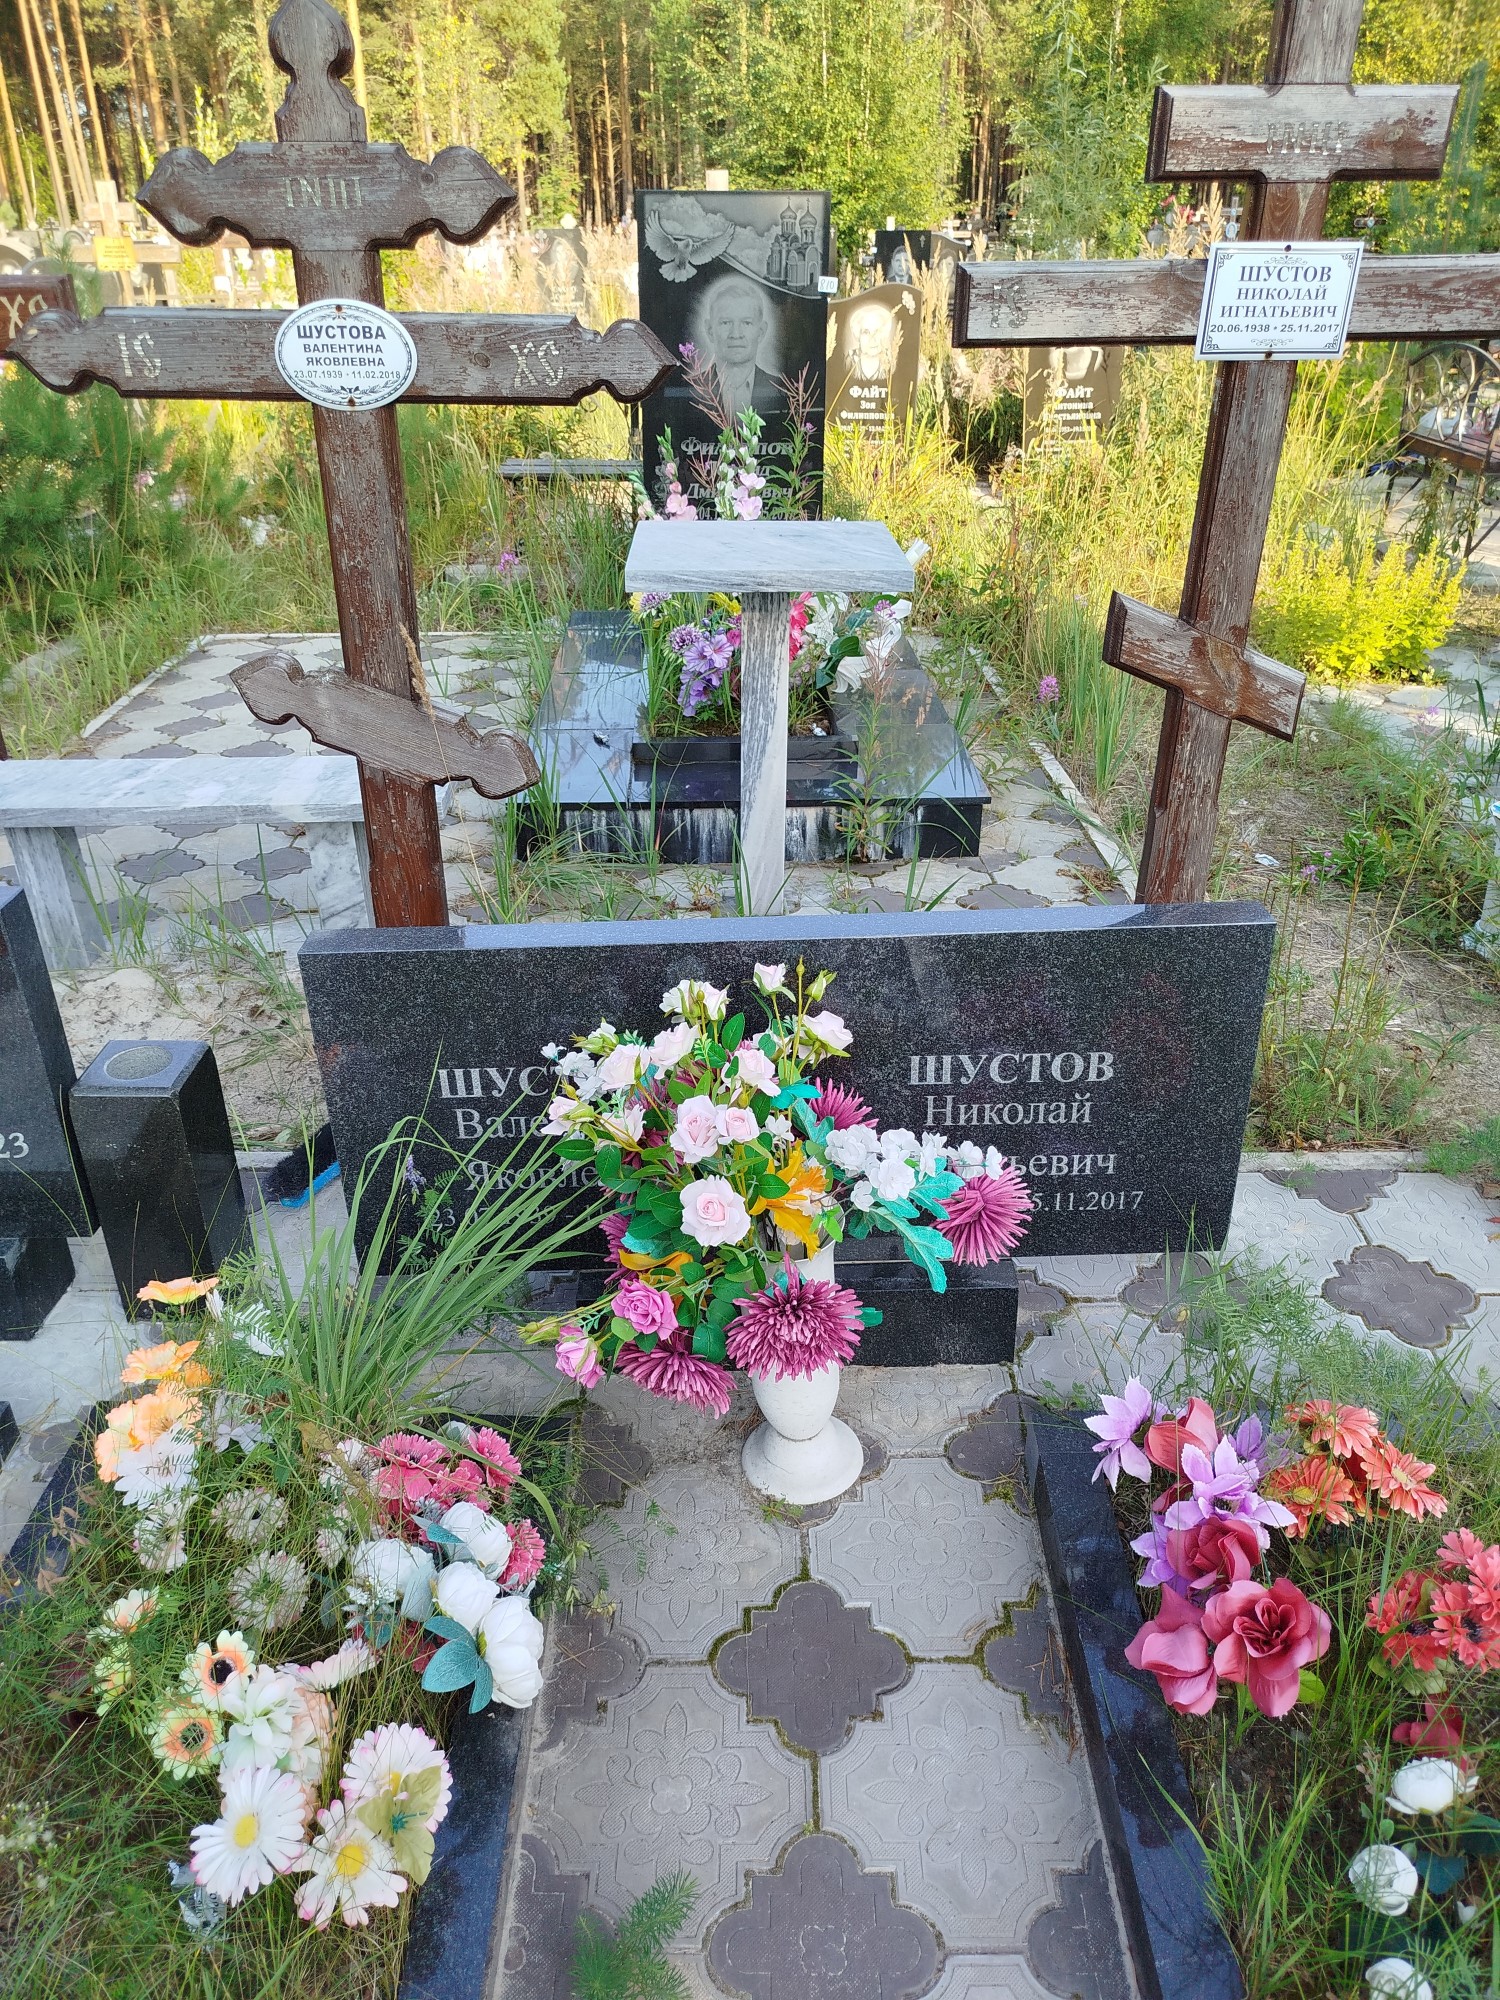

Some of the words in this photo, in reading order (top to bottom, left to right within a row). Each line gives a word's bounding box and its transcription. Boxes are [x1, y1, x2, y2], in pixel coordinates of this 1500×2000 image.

[1238, 265, 1332, 283] ШУСТОВ
[1236, 284, 1328, 301] НИКОЛАЙ
[1219, 305, 1338, 319] ИГНАТЬЕВИЧ
[296, 324, 387, 340] ШУСТОВА
[1210, 323, 1271, 333] 20.06.1938
[1280, 323, 1340, 333] 25.11.2017
[303, 343, 384, 354] ВАЛЕНТИНА
[306, 357, 386, 367] ЯКОВЛЕВНА
[293, 370, 343, 379] 23.07.1939
[351, 370, 401, 379] 11.02.2018
[849, 385, 888, 398] ФАЙТ
[1054, 385, 1094, 399] ФАЙТ
[860, 400, 876, 409] Зоя
[908, 1051, 1115, 1085] ШУСТОВ
[923, 1092, 1094, 1126] Николай
